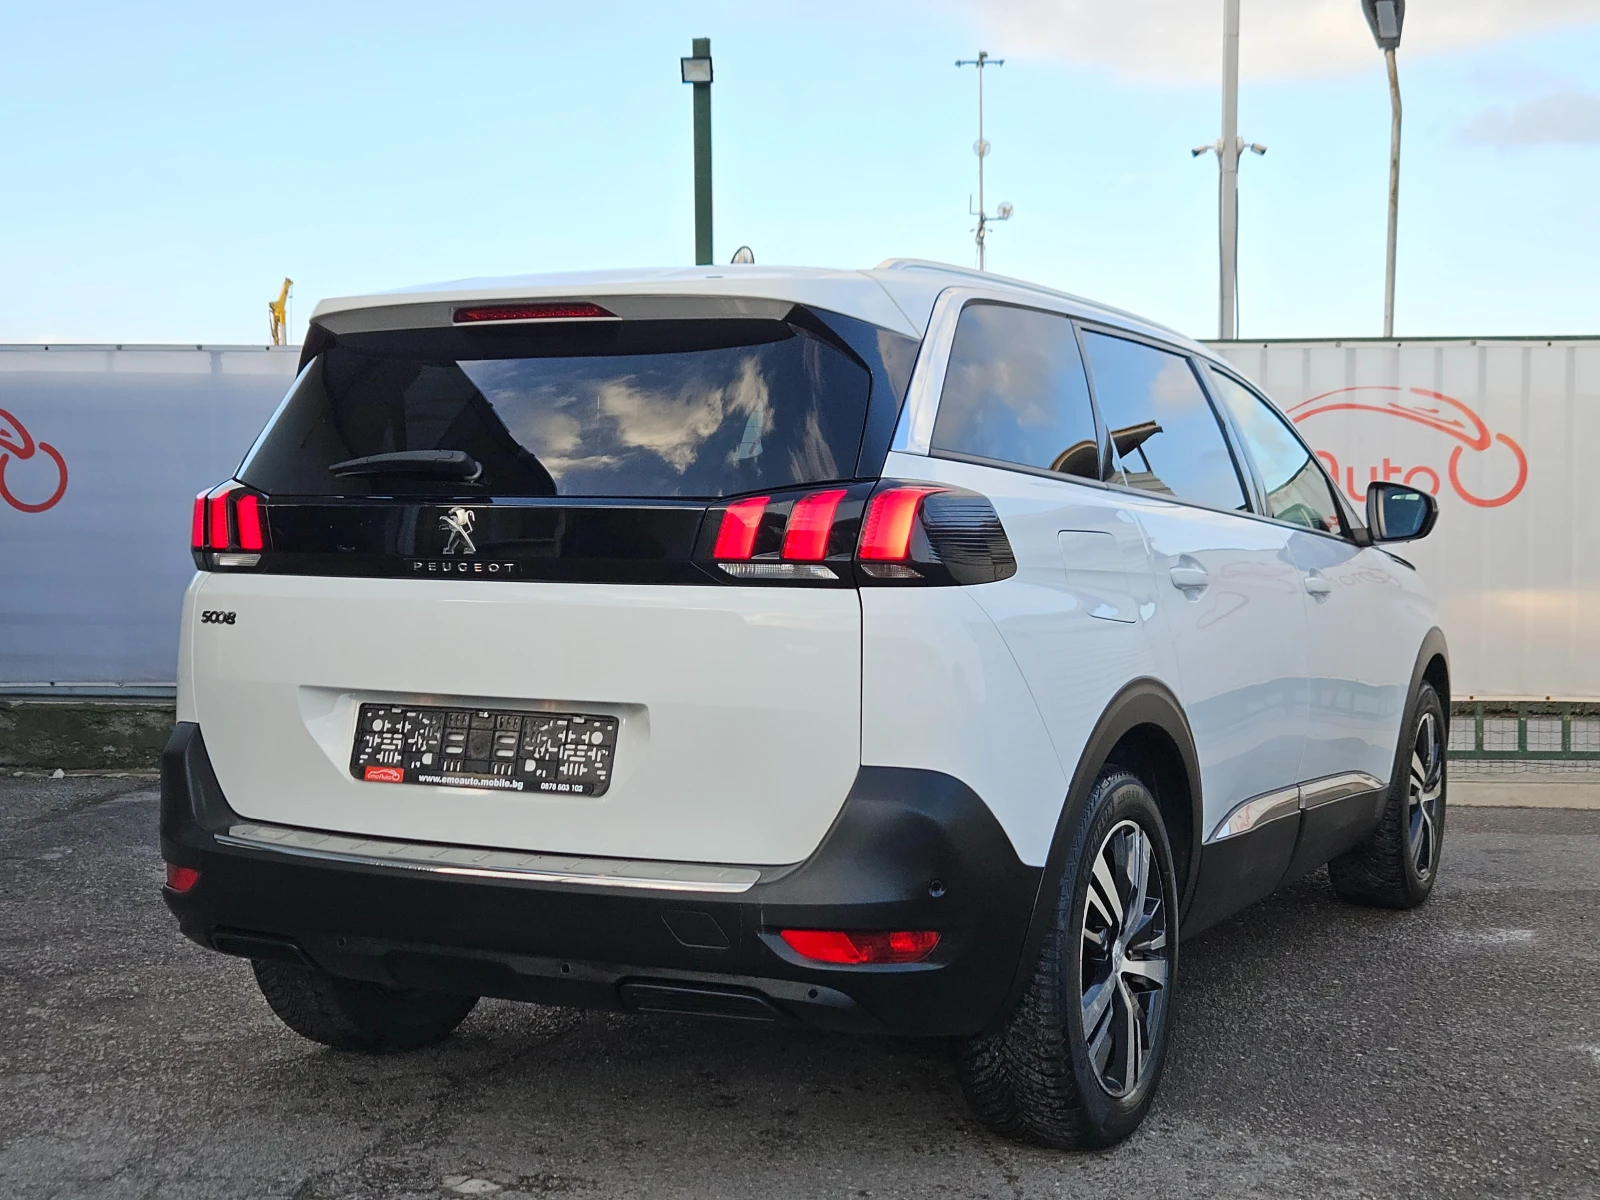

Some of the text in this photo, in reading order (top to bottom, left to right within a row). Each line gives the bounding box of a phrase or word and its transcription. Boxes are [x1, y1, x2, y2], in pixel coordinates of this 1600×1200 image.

[413, 562, 515, 573] PEUGEOT
[201, 610, 237, 625] 5008
[418, 774, 524, 790] www.emoauto.mobile.bg
[540, 782, 557, 791] 0878
[571, 784, 584, 792] 102
